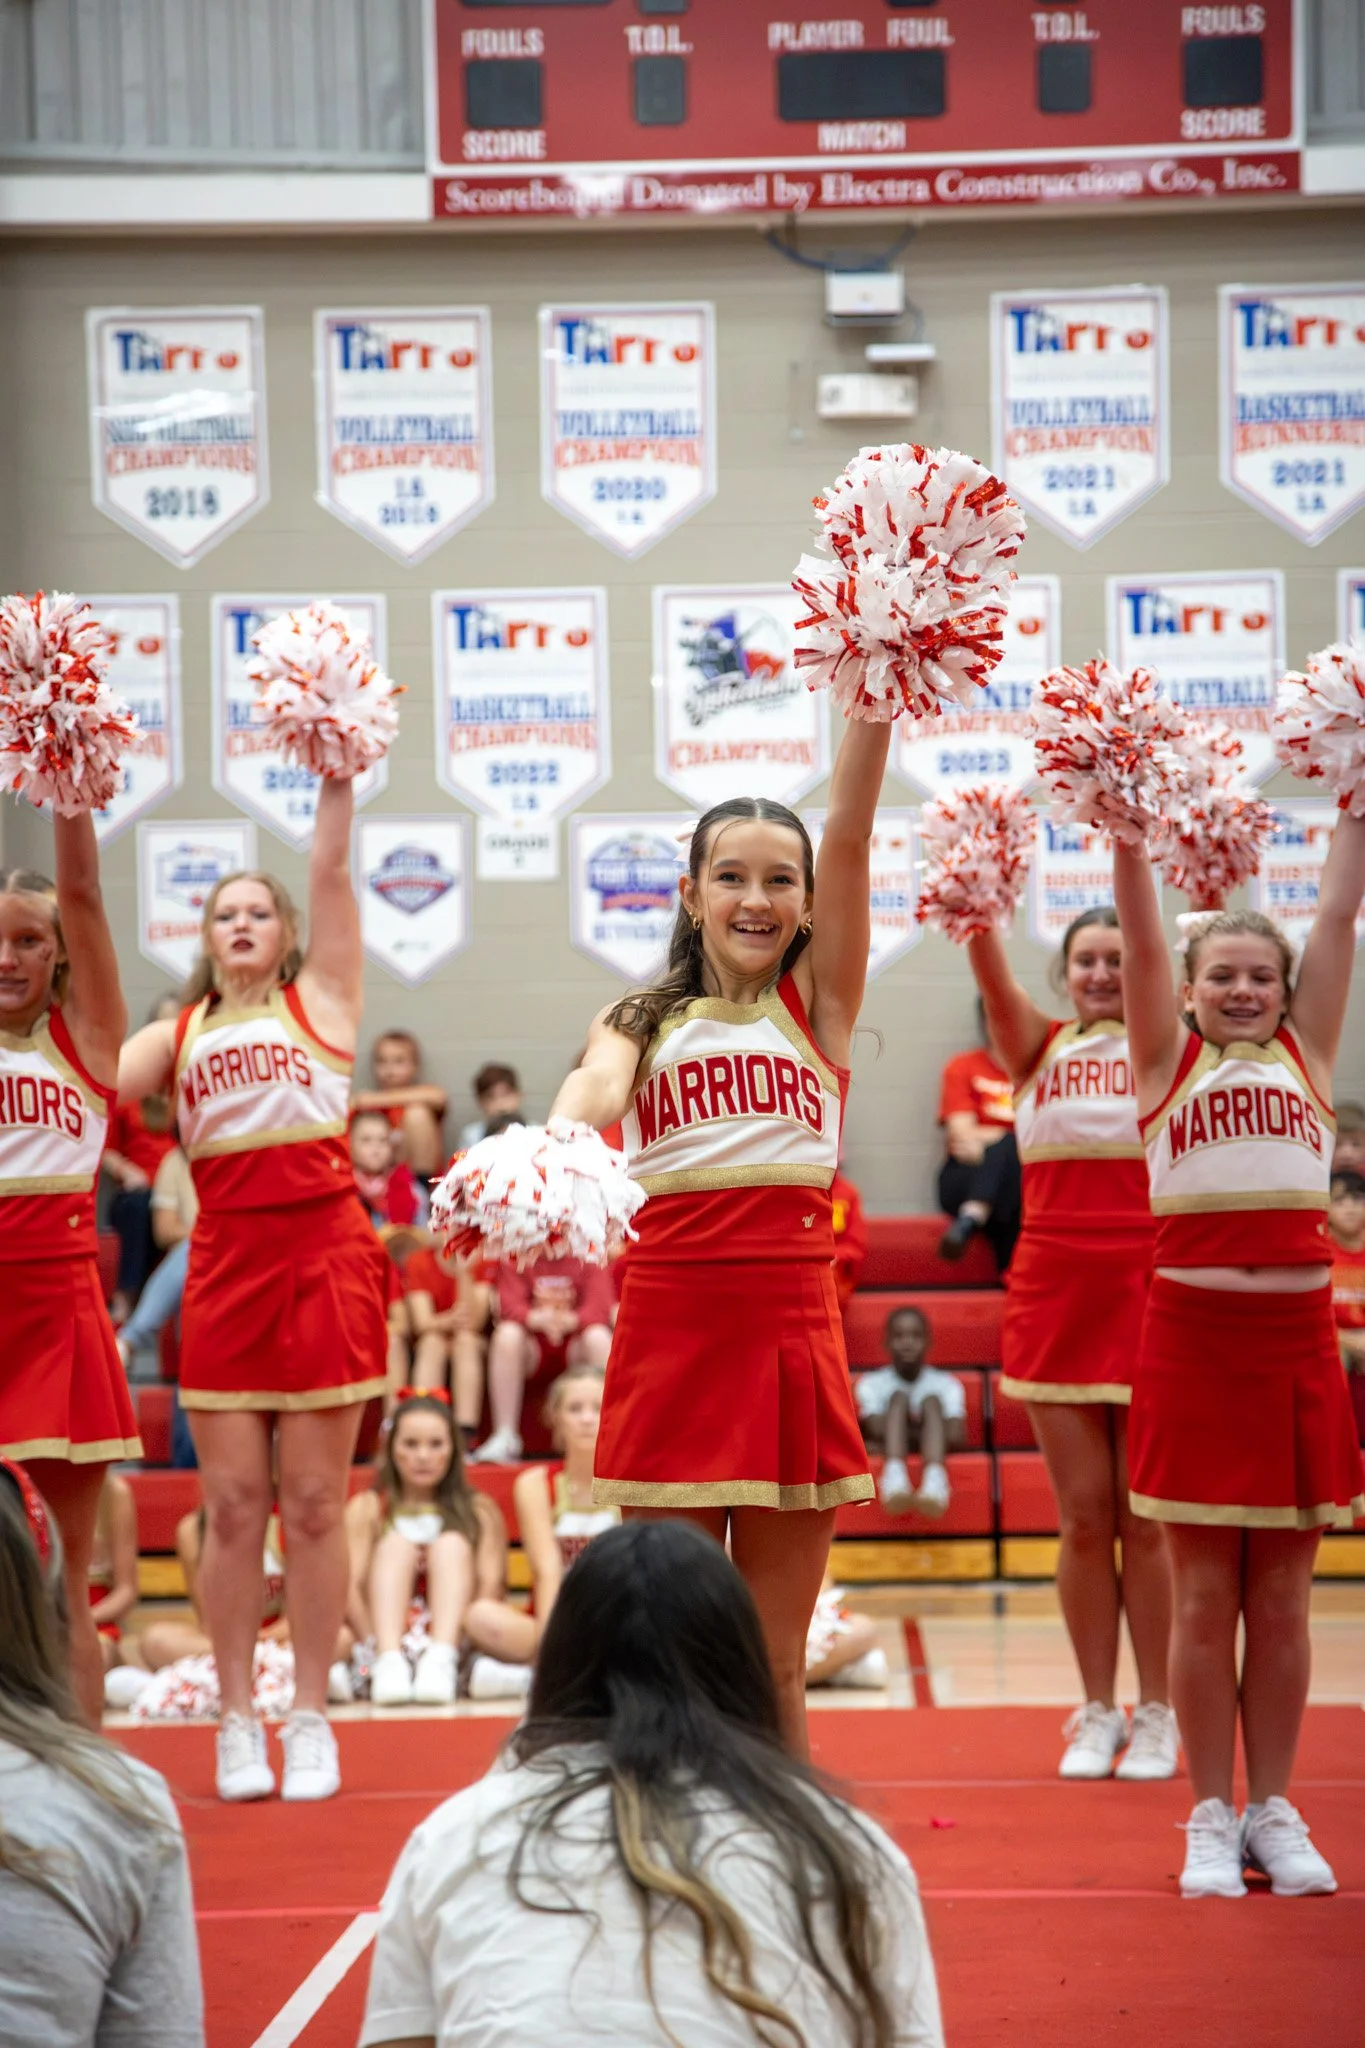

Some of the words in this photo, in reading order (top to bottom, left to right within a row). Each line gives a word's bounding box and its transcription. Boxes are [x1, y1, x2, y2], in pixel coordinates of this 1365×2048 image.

[768, 20, 864, 49] PLAYER
[1181, 5, 1266, 35] FOULS
[462, 28, 544, 57] FOULS
[817, 121, 906, 151] MATCH
[1180, 107, 1266, 139] SCORE
[463, 129, 547, 160] SCORE
[445, 178, 625, 213] Scorebo
[773, 172, 813, 211] by
[935, 166, 1143, 201] Construction
[1223, 157, 1288, 189] Inc.
[180, 1043, 312, 1113] WARRIORS
[0, 1075, 83, 1138] IORS
[633, 1052, 824, 1153] WARRIORS
[1168, 1085, 1322, 1160] WARRIORS
